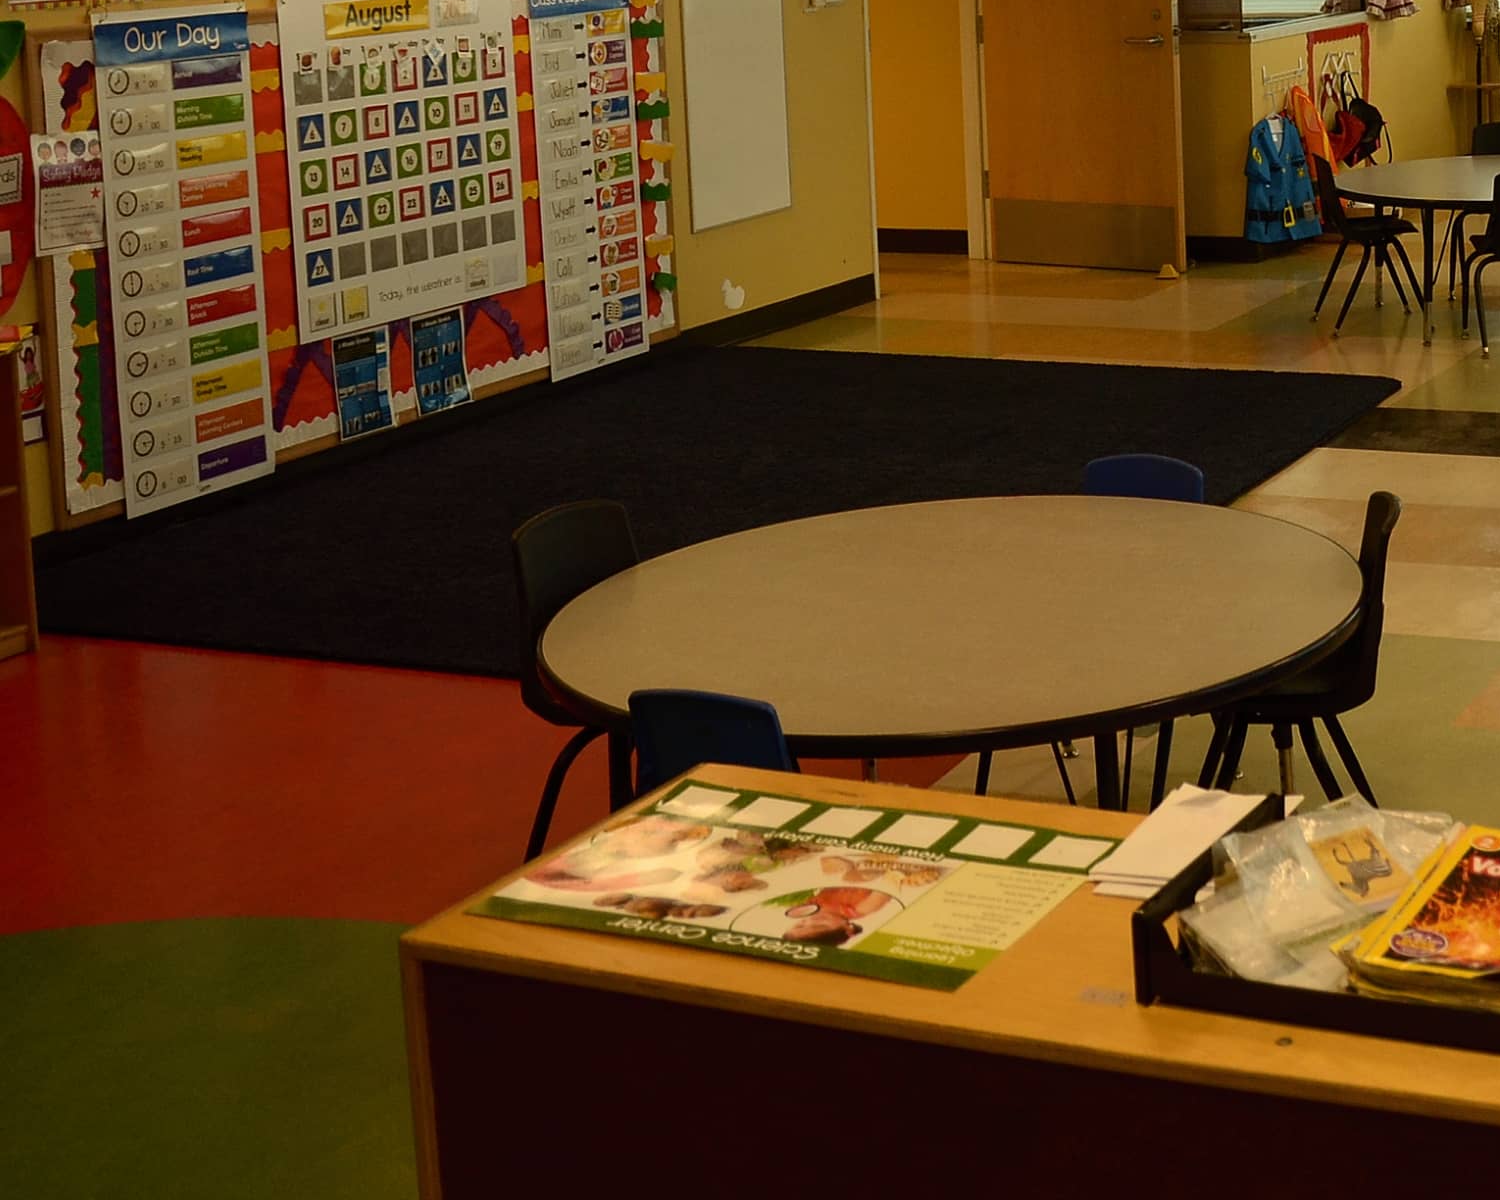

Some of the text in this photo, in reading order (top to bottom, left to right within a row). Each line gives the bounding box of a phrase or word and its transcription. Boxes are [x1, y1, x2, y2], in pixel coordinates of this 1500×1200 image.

[345, 0, 412, 31] August
[124, 23, 220, 52] Our Day
[461, 61, 468, 71] 4
[492, 59, 497, 68] 5
[309, 129, 316, 139] 6
[341, 122, 347, 132] 7
[432, 108, 441, 118] 10
[464, 104, 471, 114] 11
[493, 102, 501, 112] 12
[553, 139, 577, 159] Noah
[309, 172, 318, 183] 13
[340, 166, 350, 177] 14
[374, 164, 382, 174] 15
[405, 156, 414, 166] 16
[436, 151, 444, 161] 17
[494, 140, 502, 150] 19
[312, 181, 505, 227] 20 21 22 23 24 25 26
[552, 197, 576, 220] Wyatt
[815, 836, 848, 847] can
[850, 841, 900, 854] many
[1480, 837, 1494, 849] 2
[902, 848, 946, 863] How
[607, 918, 821, 960] Science Center
[889, 946, 956, 964] Learning
